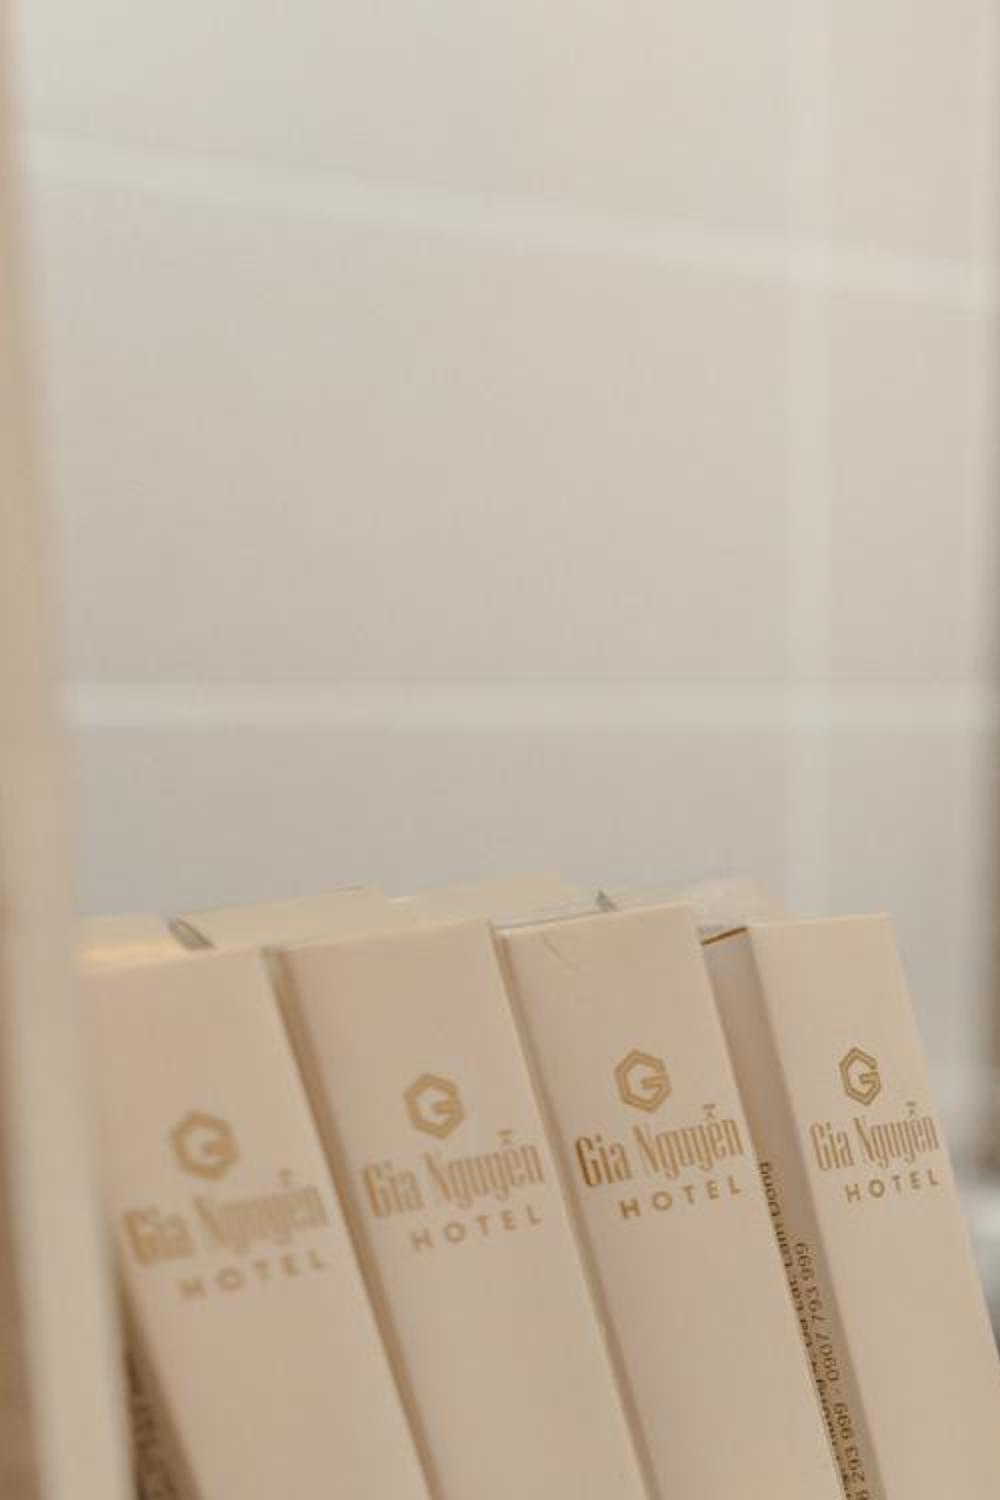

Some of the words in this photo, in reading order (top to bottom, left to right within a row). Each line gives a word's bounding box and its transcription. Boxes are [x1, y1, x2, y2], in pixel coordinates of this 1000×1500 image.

[575, 1133, 632, 1187] Gia
[809, 1120, 855, 1170] Gia
[363, 1160, 425, 1218] Gia
[619, 1175, 741, 1219] HOTEL
[845, 1169, 938, 1203] HOTEL
[410, 1203, 542, 1251] HOTEL
[179, 1247, 326, 1300] HOTEL
